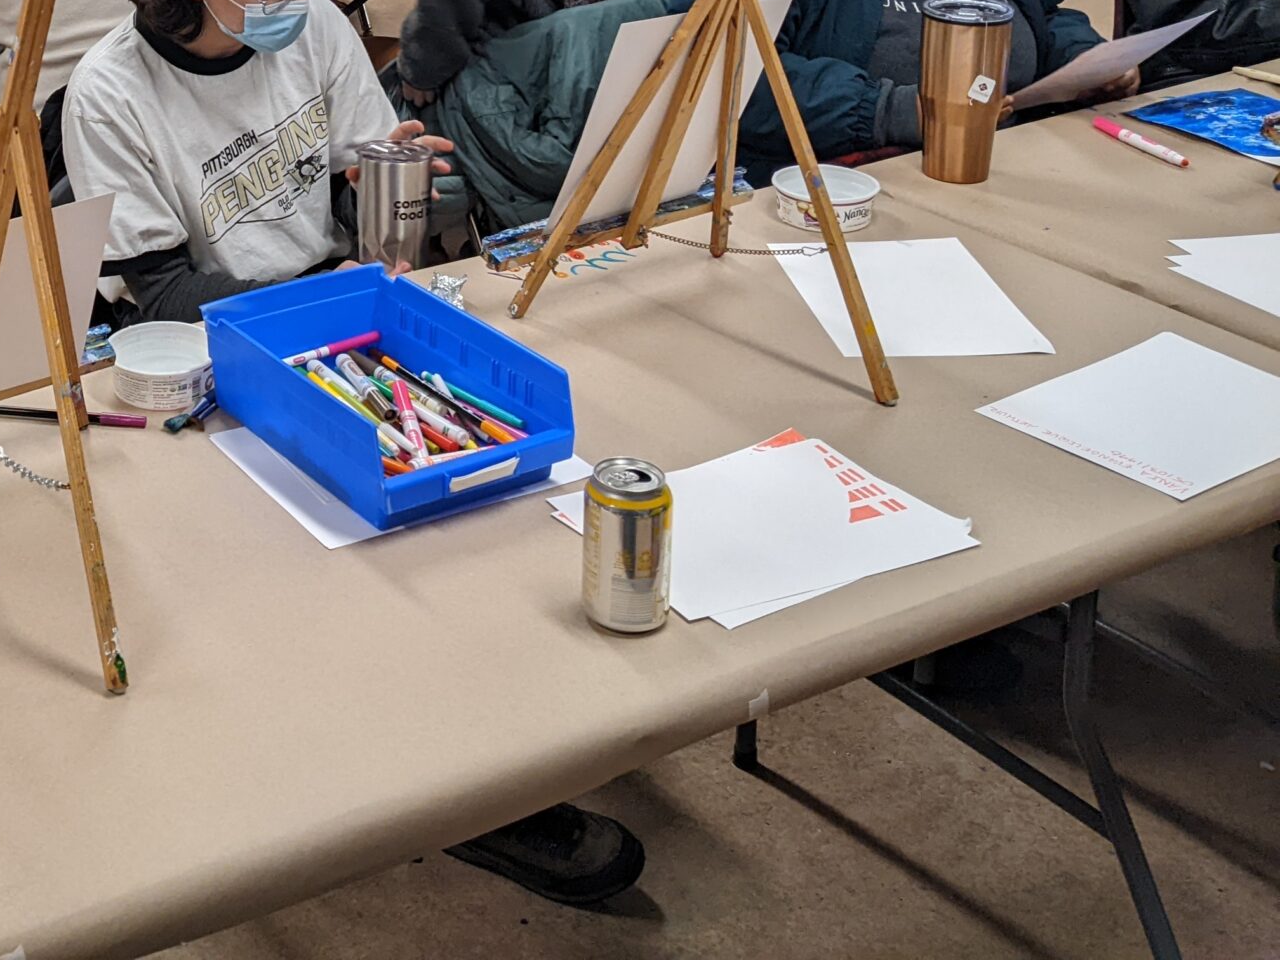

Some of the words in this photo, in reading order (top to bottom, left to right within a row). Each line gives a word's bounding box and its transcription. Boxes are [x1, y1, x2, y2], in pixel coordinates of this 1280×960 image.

[200, 100, 329, 238] PENGINS
[201, 129, 259, 179] PITTSBURGH
[394, 208, 424, 221] food
